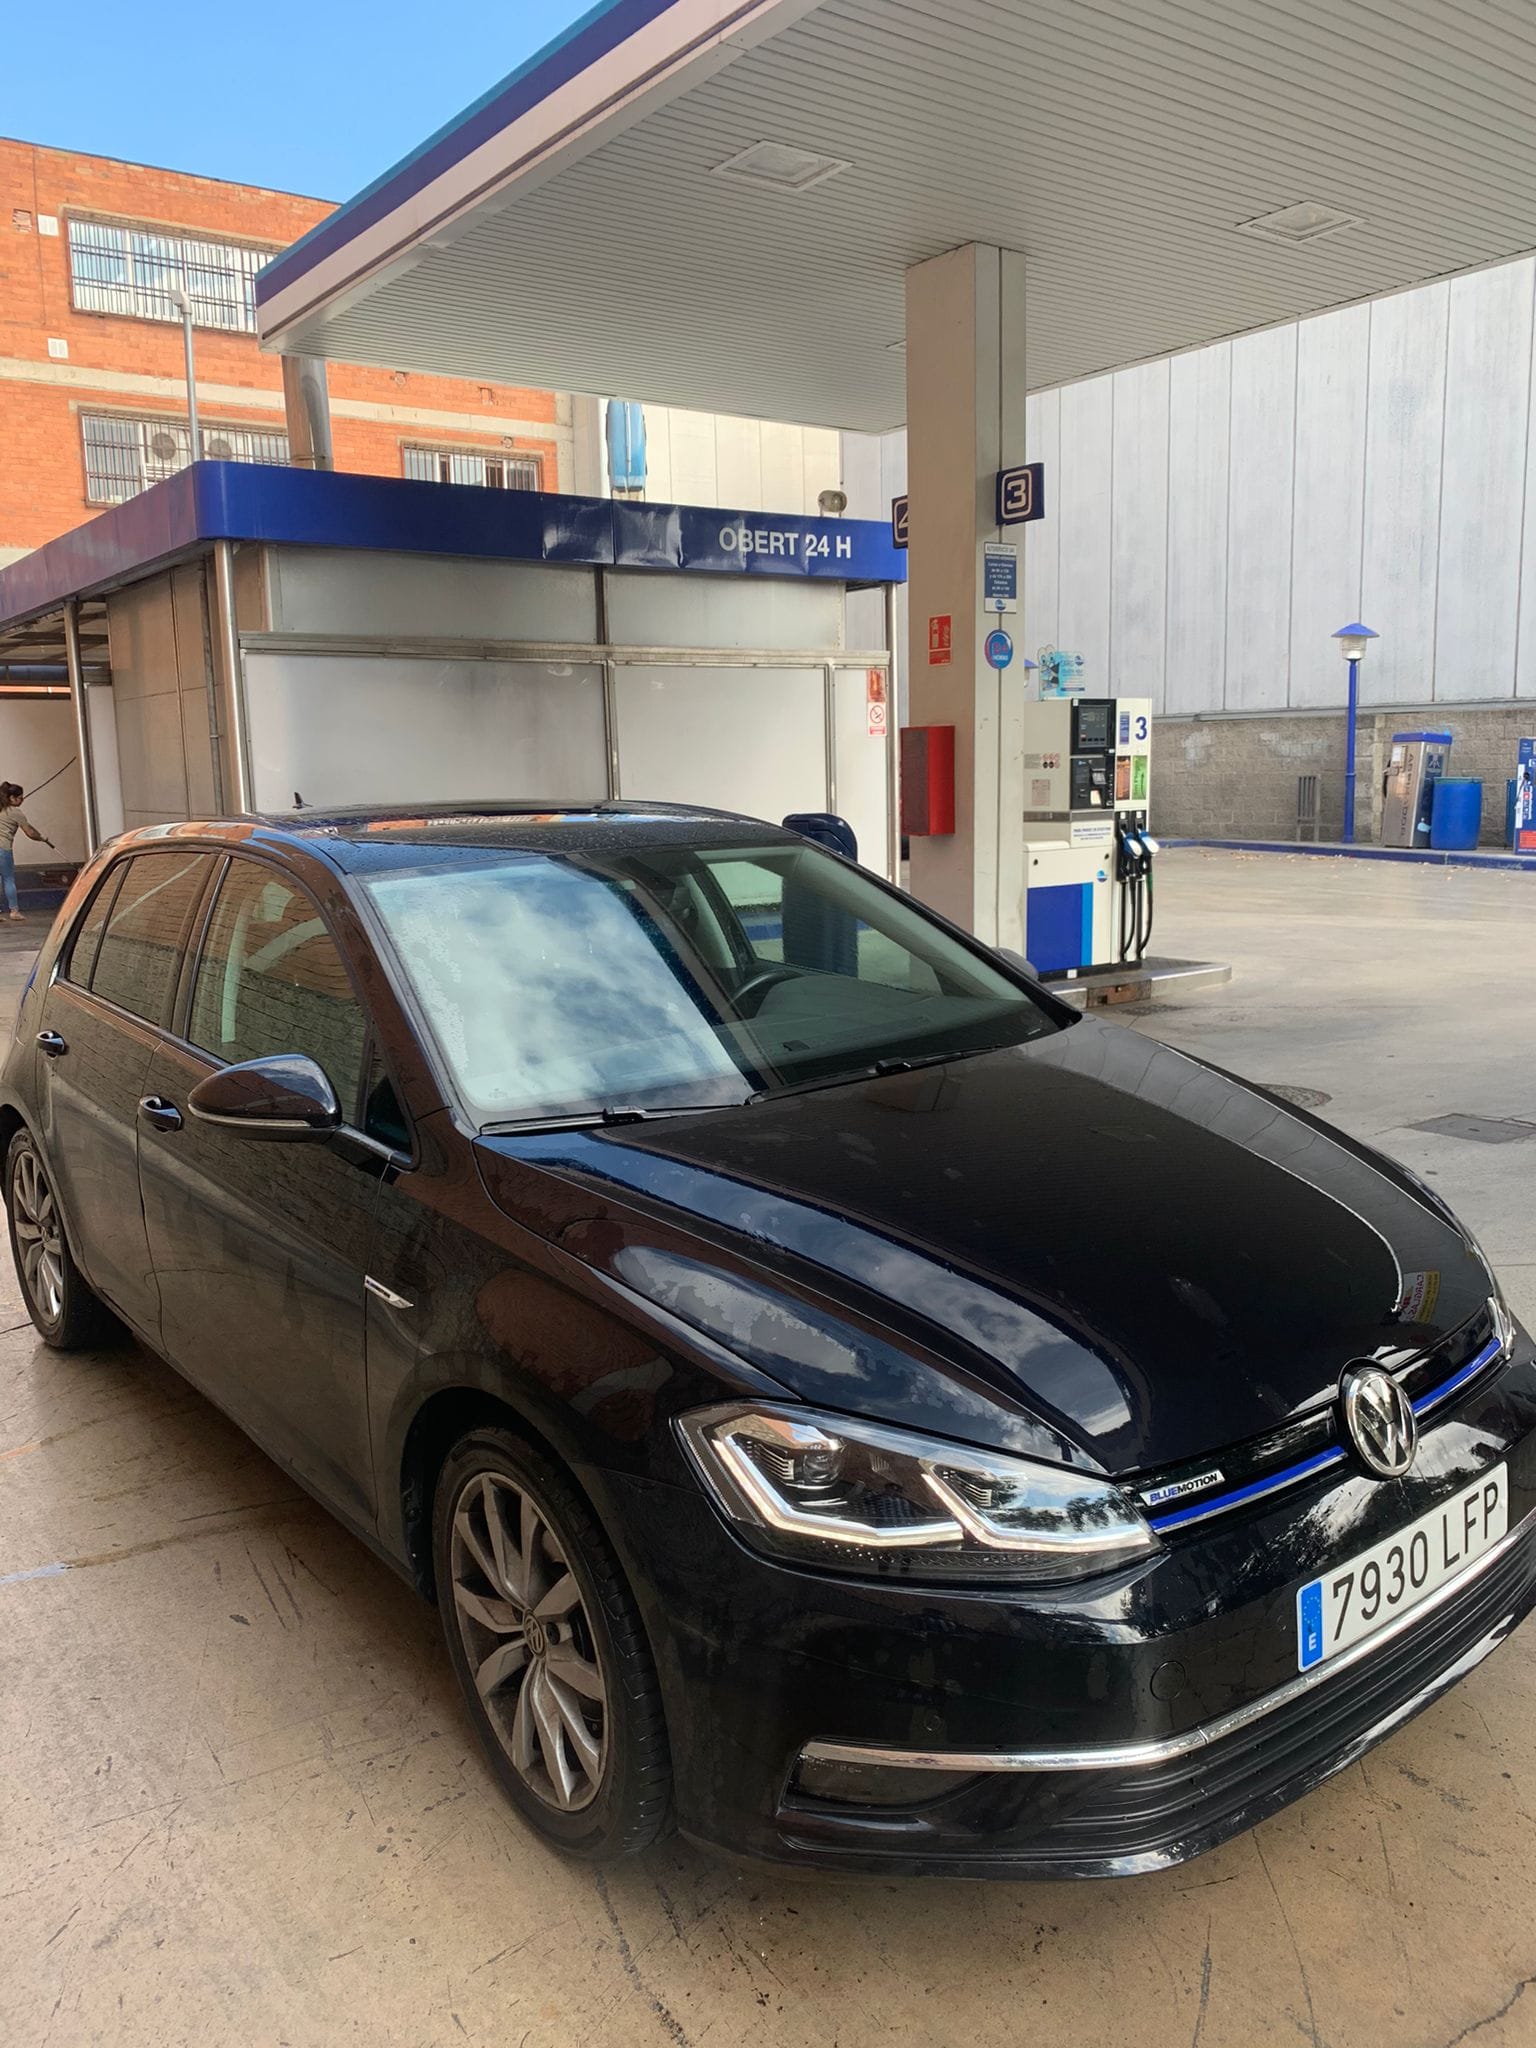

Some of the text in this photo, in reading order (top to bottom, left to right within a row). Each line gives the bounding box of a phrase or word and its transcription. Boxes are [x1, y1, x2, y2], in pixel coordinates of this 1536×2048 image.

[1006, 479, 1026, 510] 3
[718, 526, 851, 559] OBERT 24 H
[1135, 716, 1148, 741] 3
[1149, 1472, 1219, 1502] BLUEMOTION
[1332, 1481, 1499, 1642] 7930 LFP
[1308, 1631, 1318, 1652] E
